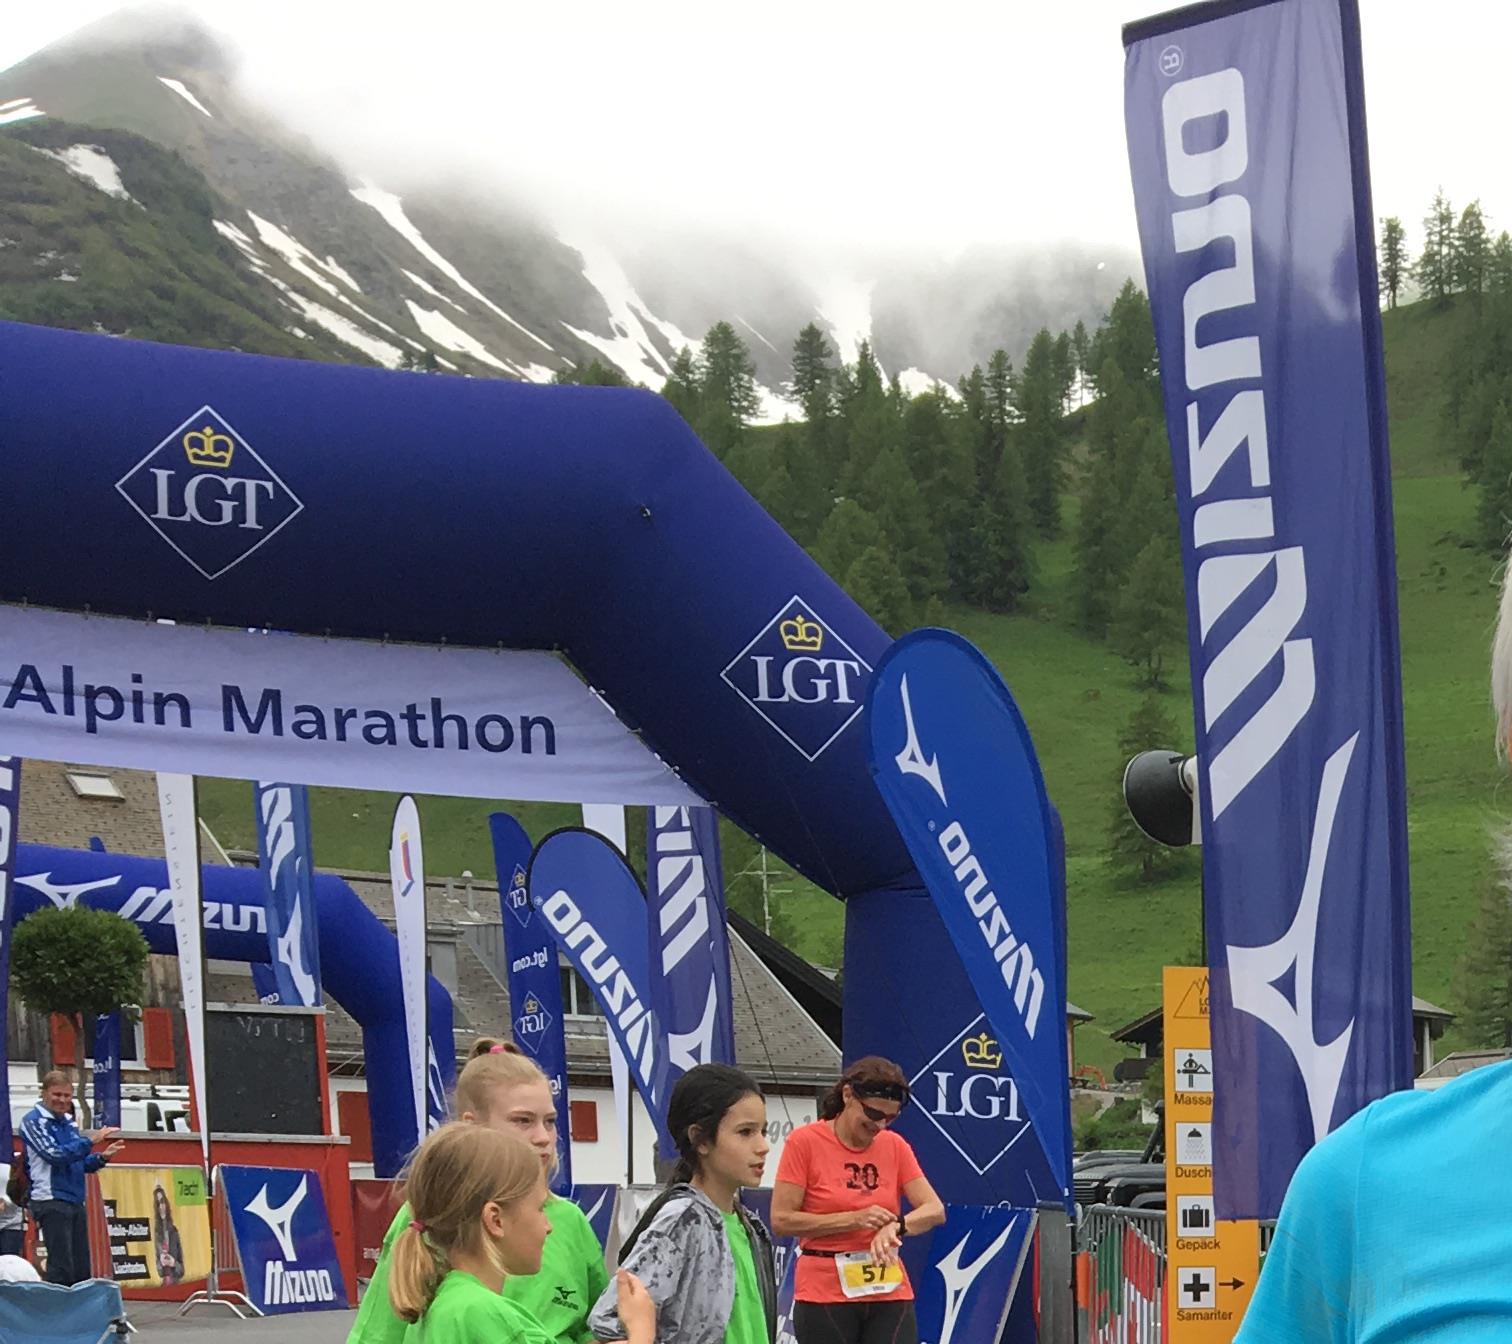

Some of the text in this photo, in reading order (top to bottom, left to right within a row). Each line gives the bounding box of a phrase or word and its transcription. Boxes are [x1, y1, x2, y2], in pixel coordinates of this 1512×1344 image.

[1162, 67, 1316, 822] MIZUNO
[150, 468, 274, 530] LGT
[751, 656, 861, 704] LGT
[3, 663, 557, 755] Alpin Marathon
[938, 821, 1045, 1041] MIZUNO
[844, 1162, 879, 1190] 20
[1176, 1238, 1221, 1252] Gepäck
[264, 1259, 333, 1306] MIZUNO
[1176, 1309, 1233, 1323] Samariter
